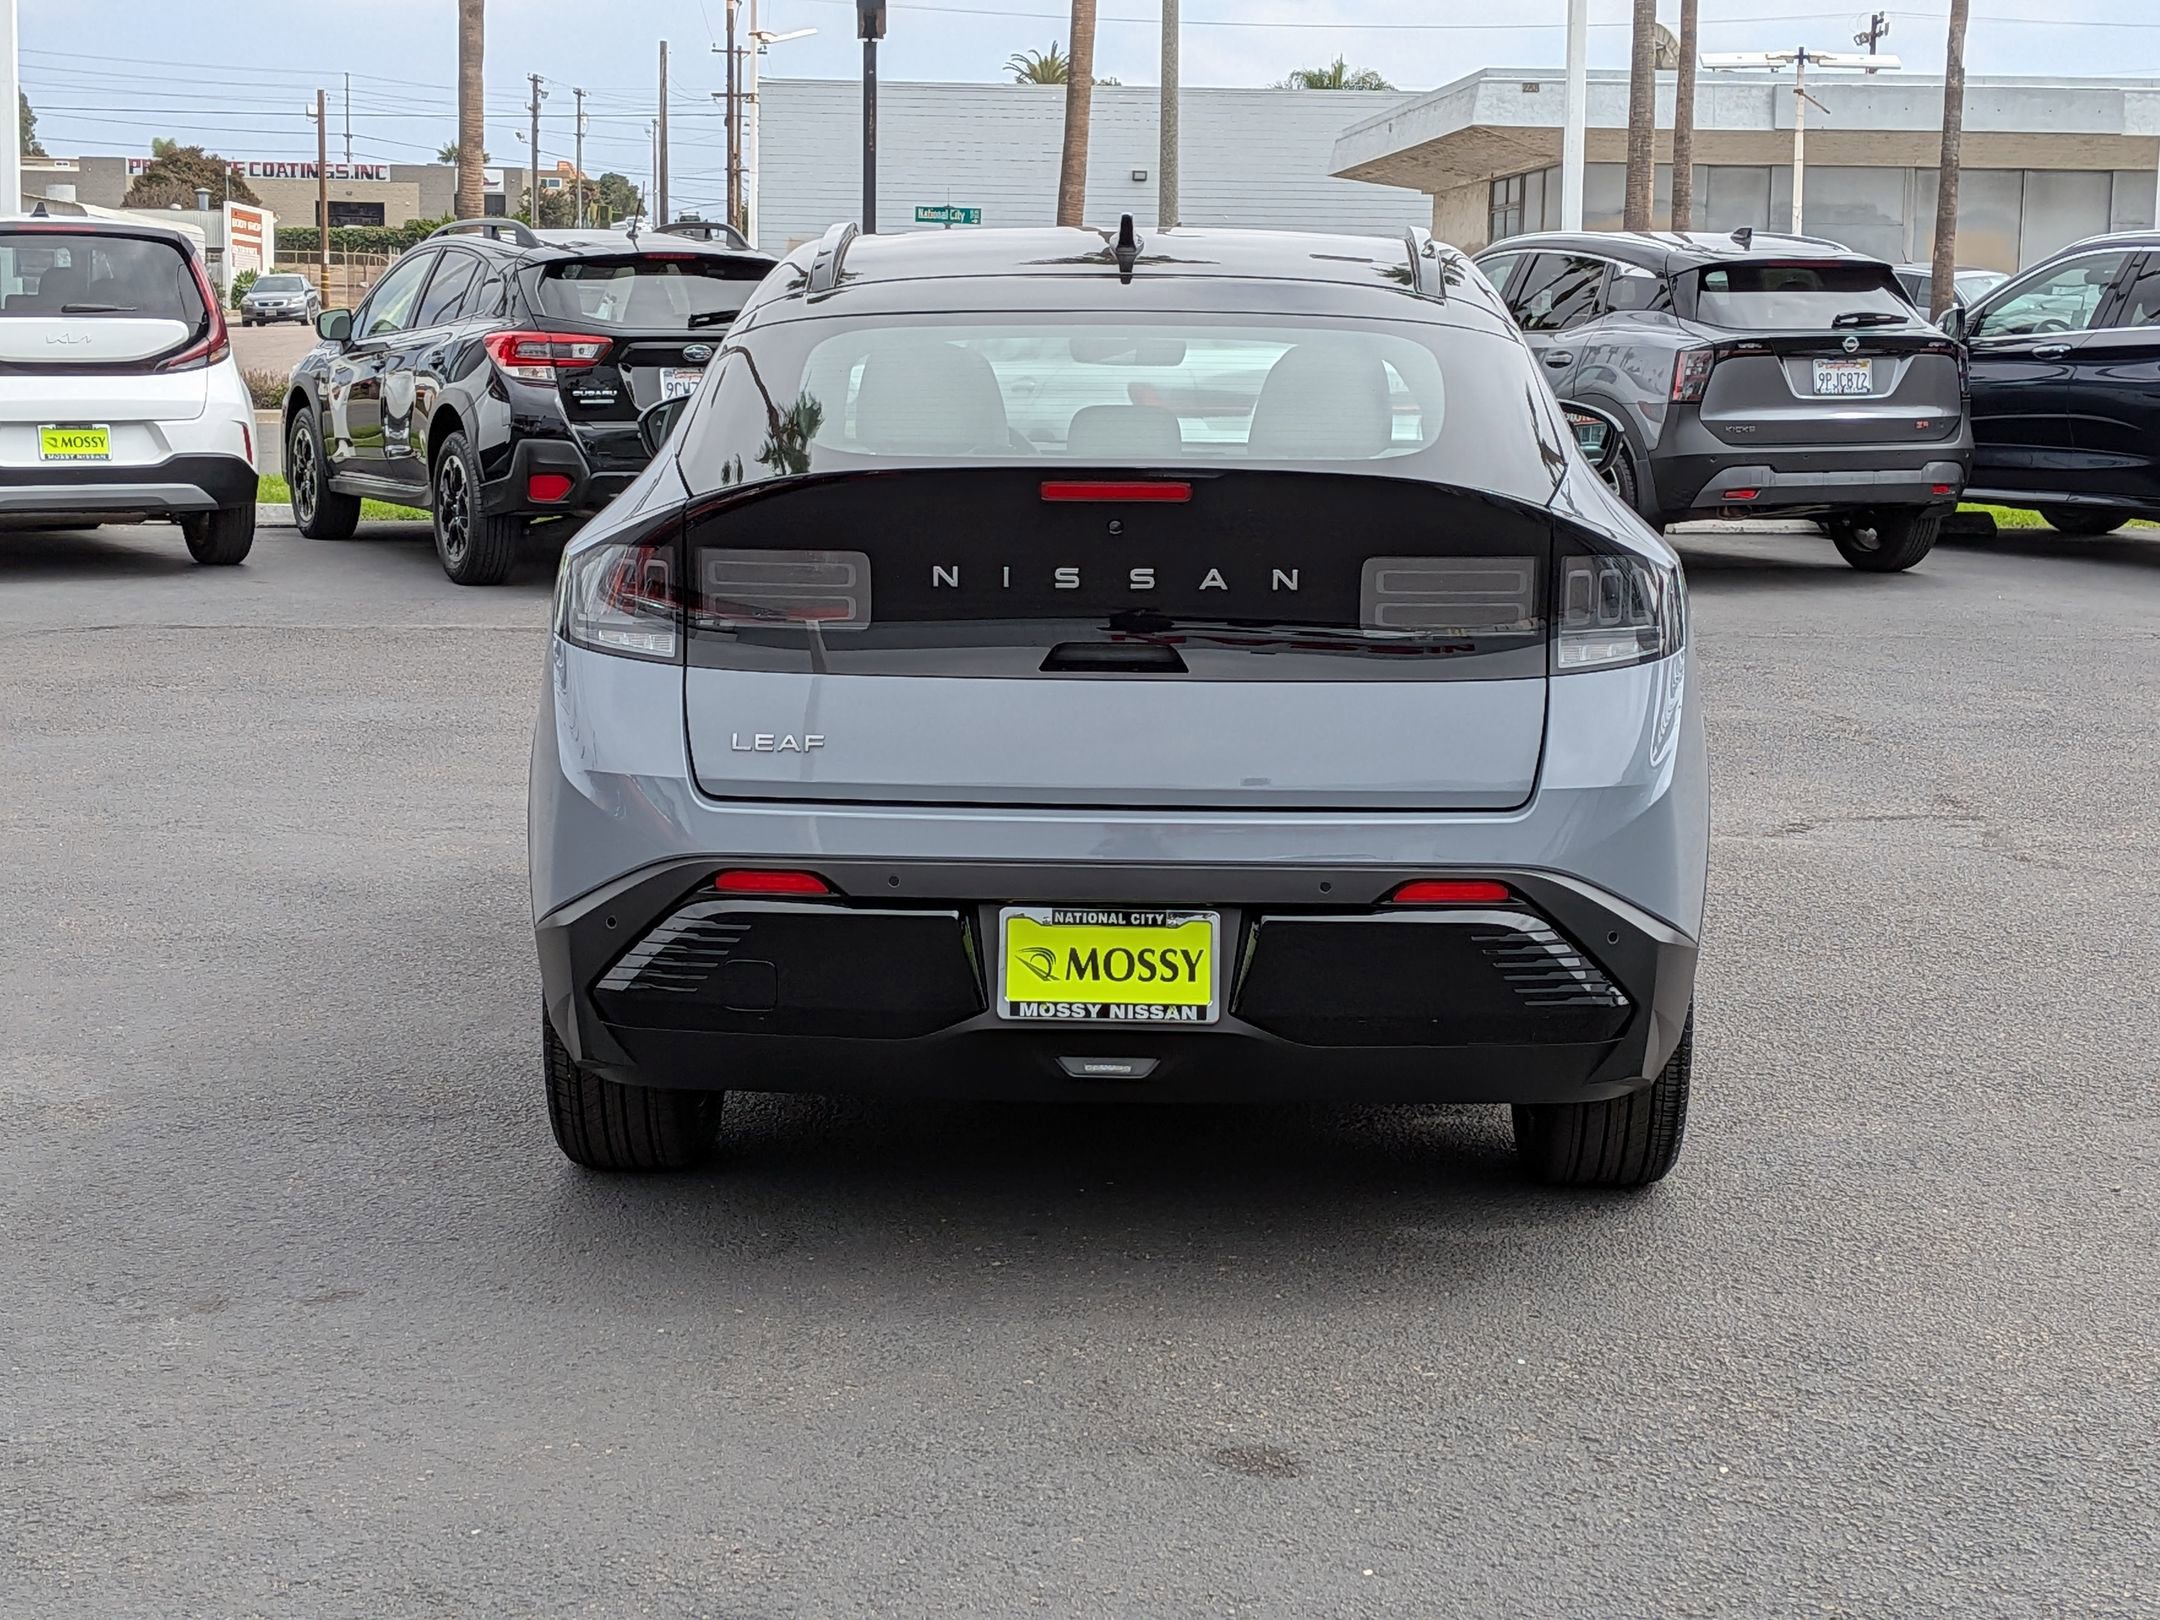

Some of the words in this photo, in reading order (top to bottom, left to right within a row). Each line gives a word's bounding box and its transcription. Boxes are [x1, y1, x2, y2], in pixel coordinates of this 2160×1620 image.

[918, 207, 949, 220] National
[949, 208, 966, 224] City
[1818, 372, 1868, 391] 9PJC872
[60, 435, 106, 449] MOSSY
[932, 564, 1300, 592] NISSAN
[731, 732, 826, 753] LEAF
[1054, 911, 1127, 926] NATIONAL
[1130, 912, 1165, 926] CITY
[1065, 947, 1205, 983] MOSSY
[1019, 1002, 1104, 1018] MOSSY
[1109, 1004, 1198, 1020] NISSAN
